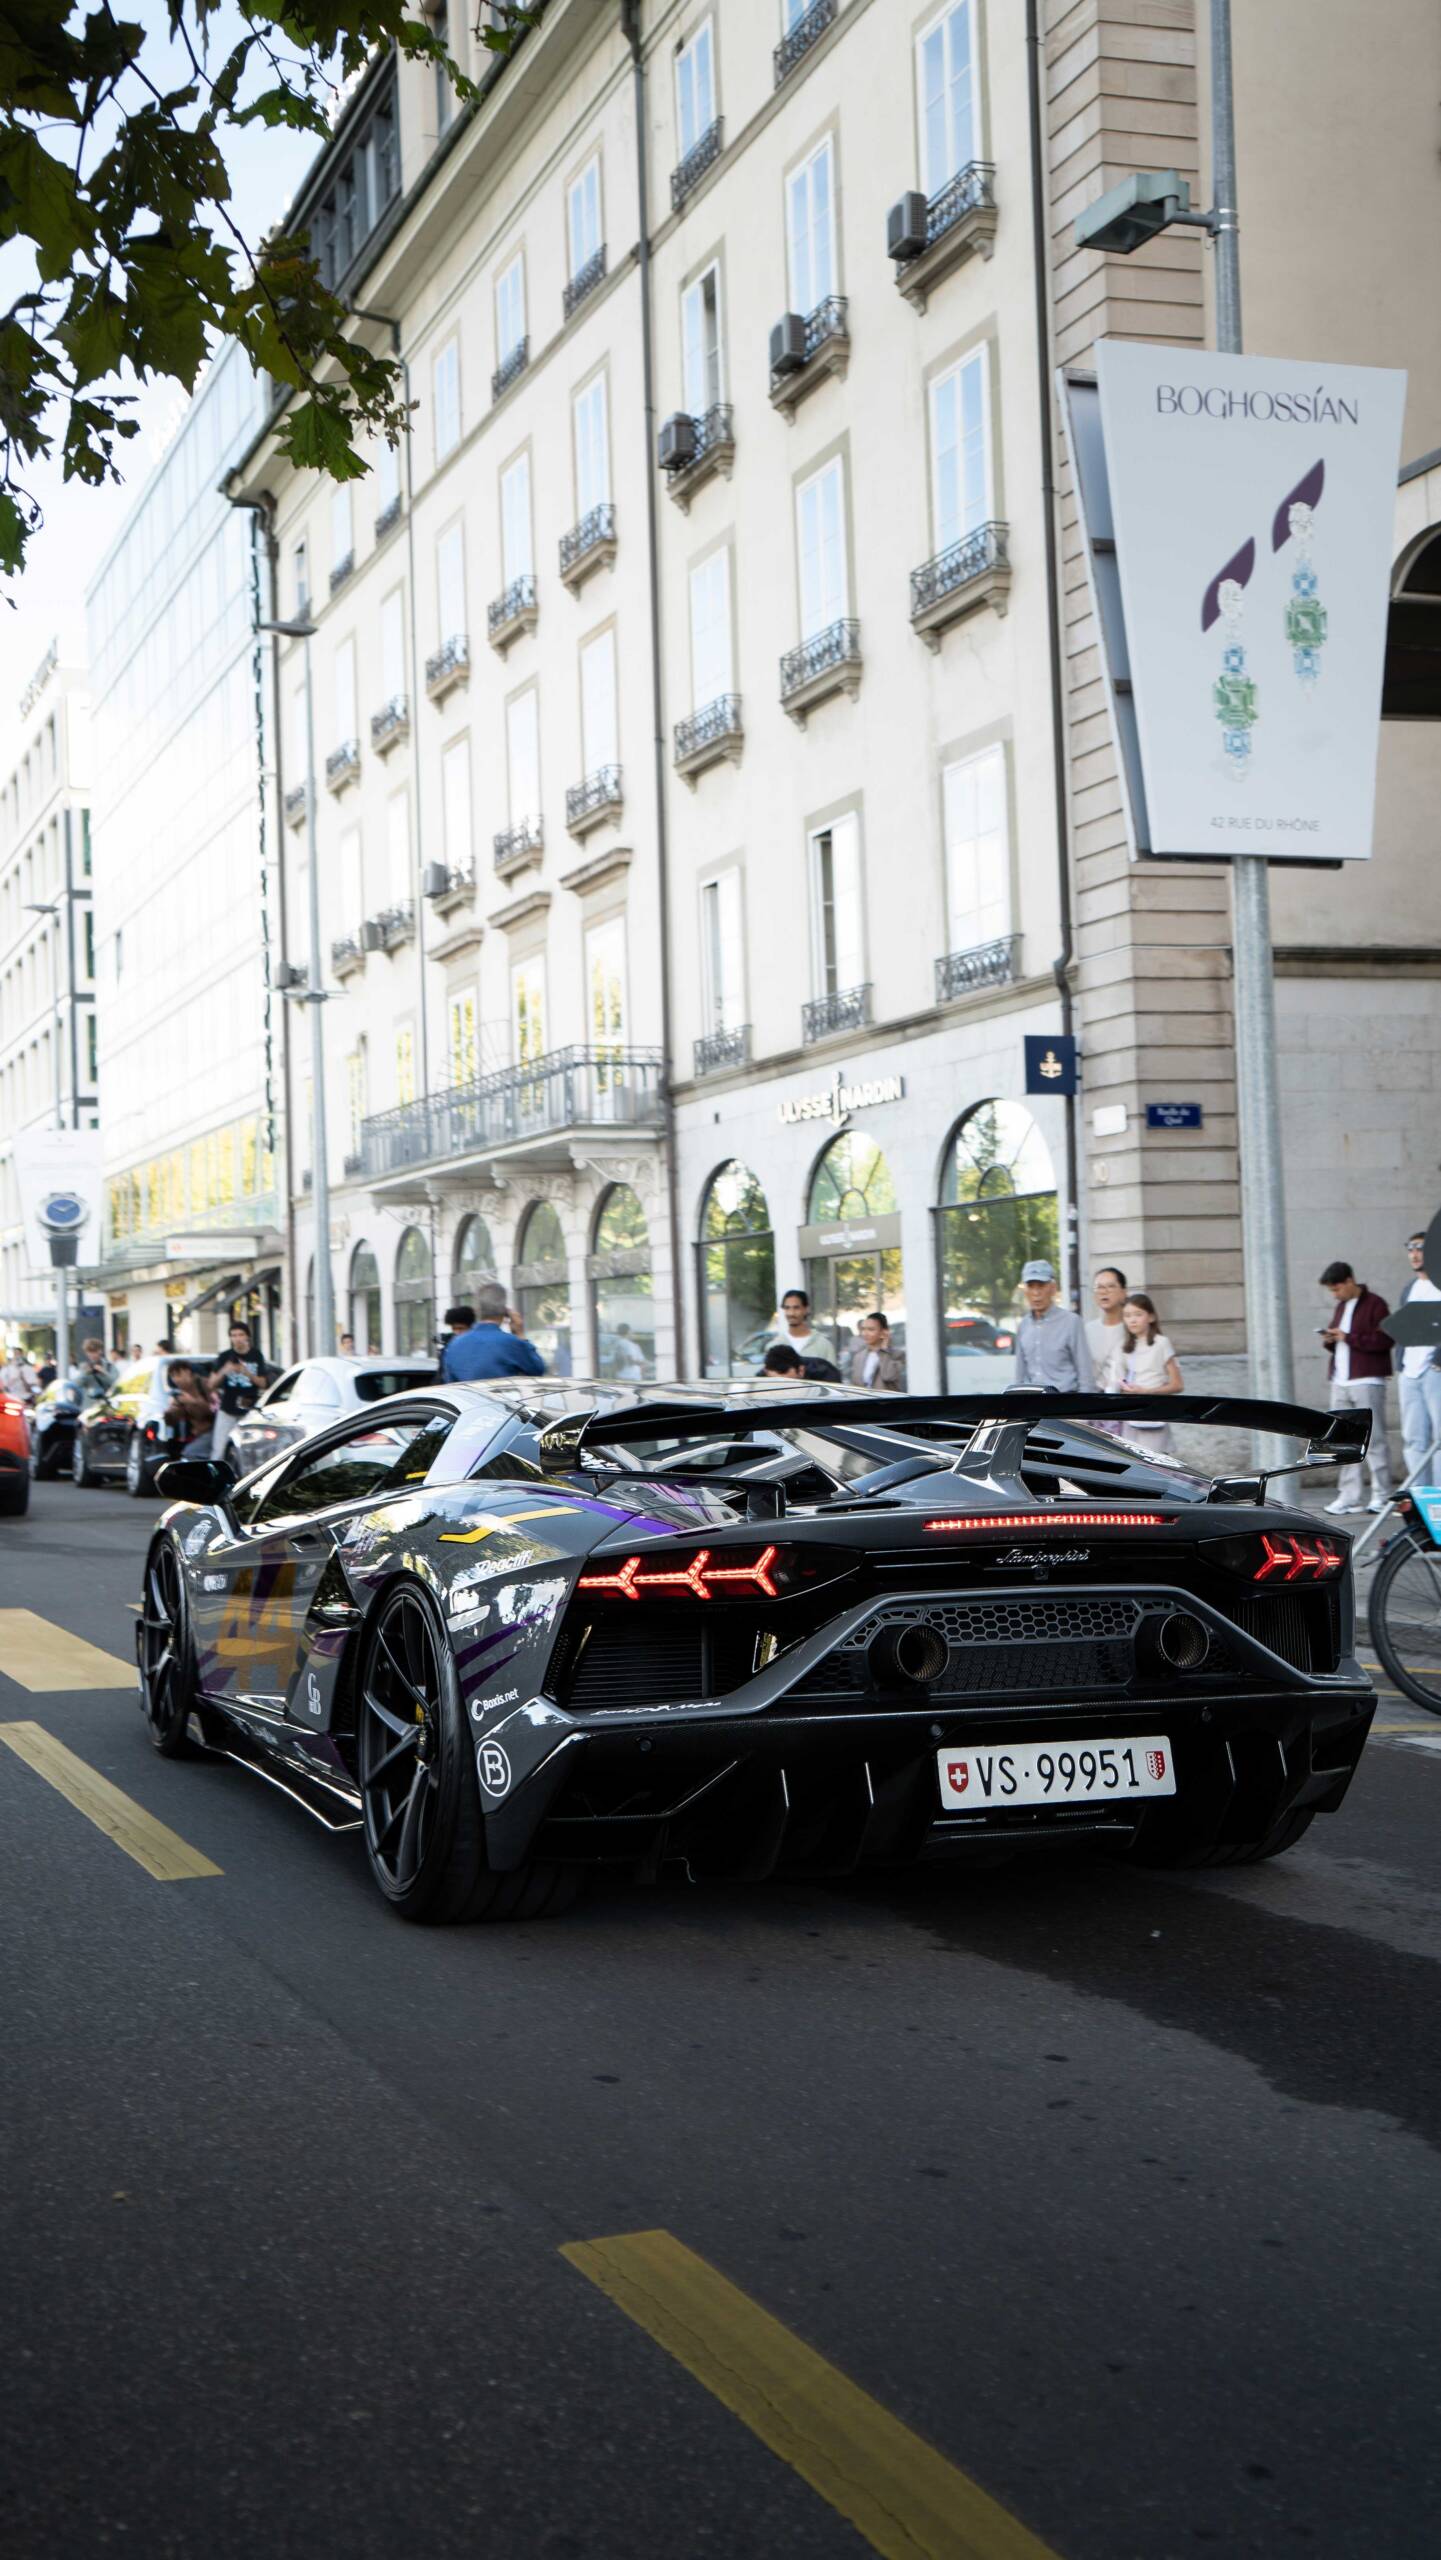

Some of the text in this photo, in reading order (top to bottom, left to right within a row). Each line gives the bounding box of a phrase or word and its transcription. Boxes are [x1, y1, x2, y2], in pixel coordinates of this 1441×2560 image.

[1227, 816, 1253, 830] RUE
[1255, 817, 1274, 831] DU
[839, 1075, 905, 1112] NARDIN
